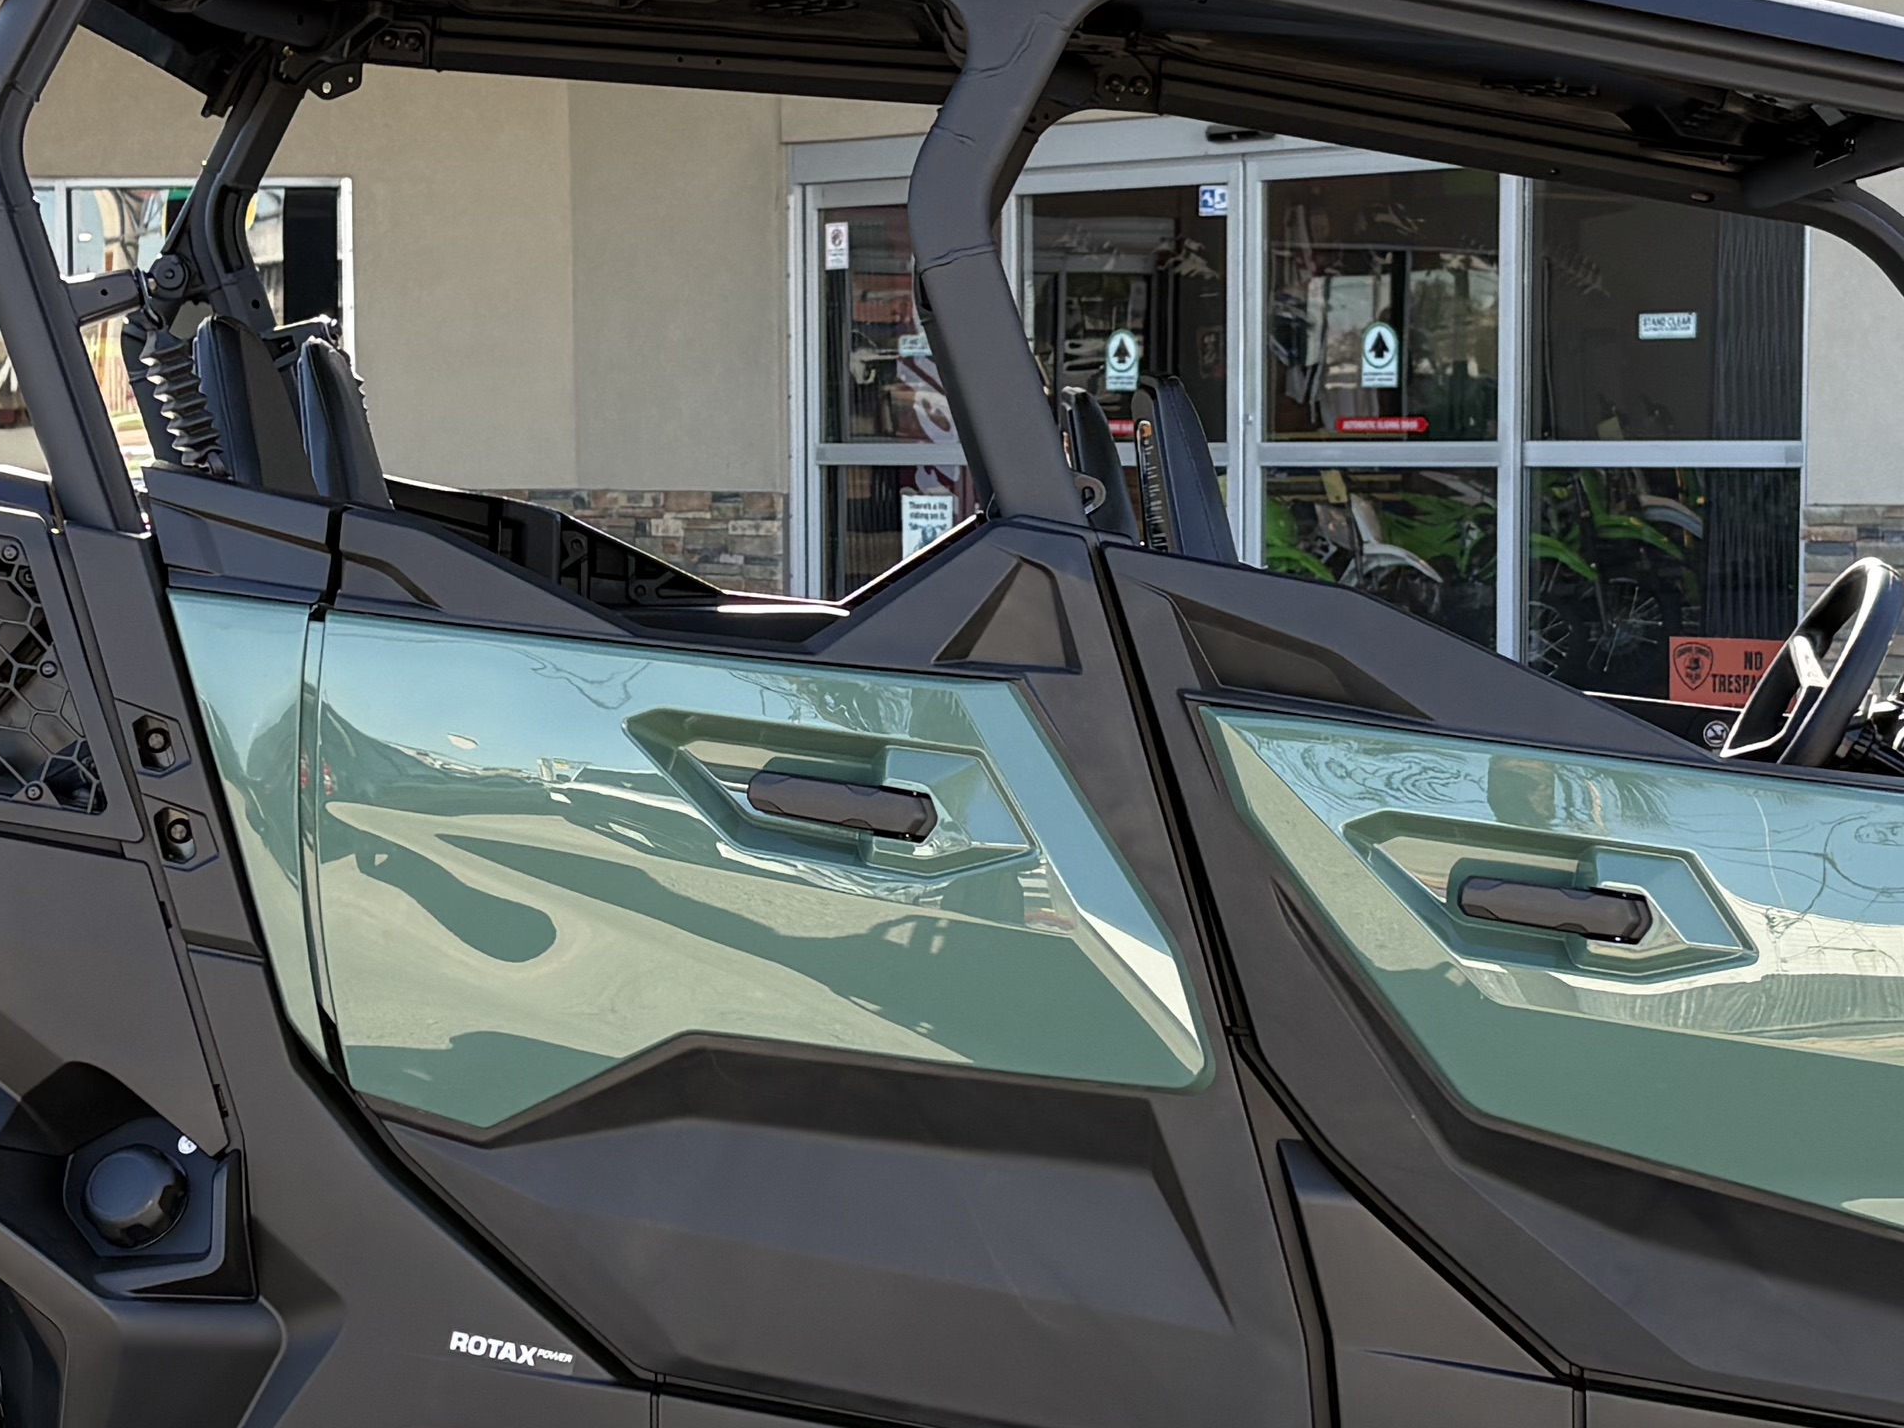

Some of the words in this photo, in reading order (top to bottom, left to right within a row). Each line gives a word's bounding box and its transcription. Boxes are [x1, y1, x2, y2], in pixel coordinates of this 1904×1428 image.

[1744, 651, 1764, 671] NO
[449, 1331, 538, 1367] ROTAX
[536, 1348, 574, 1364] POWER
